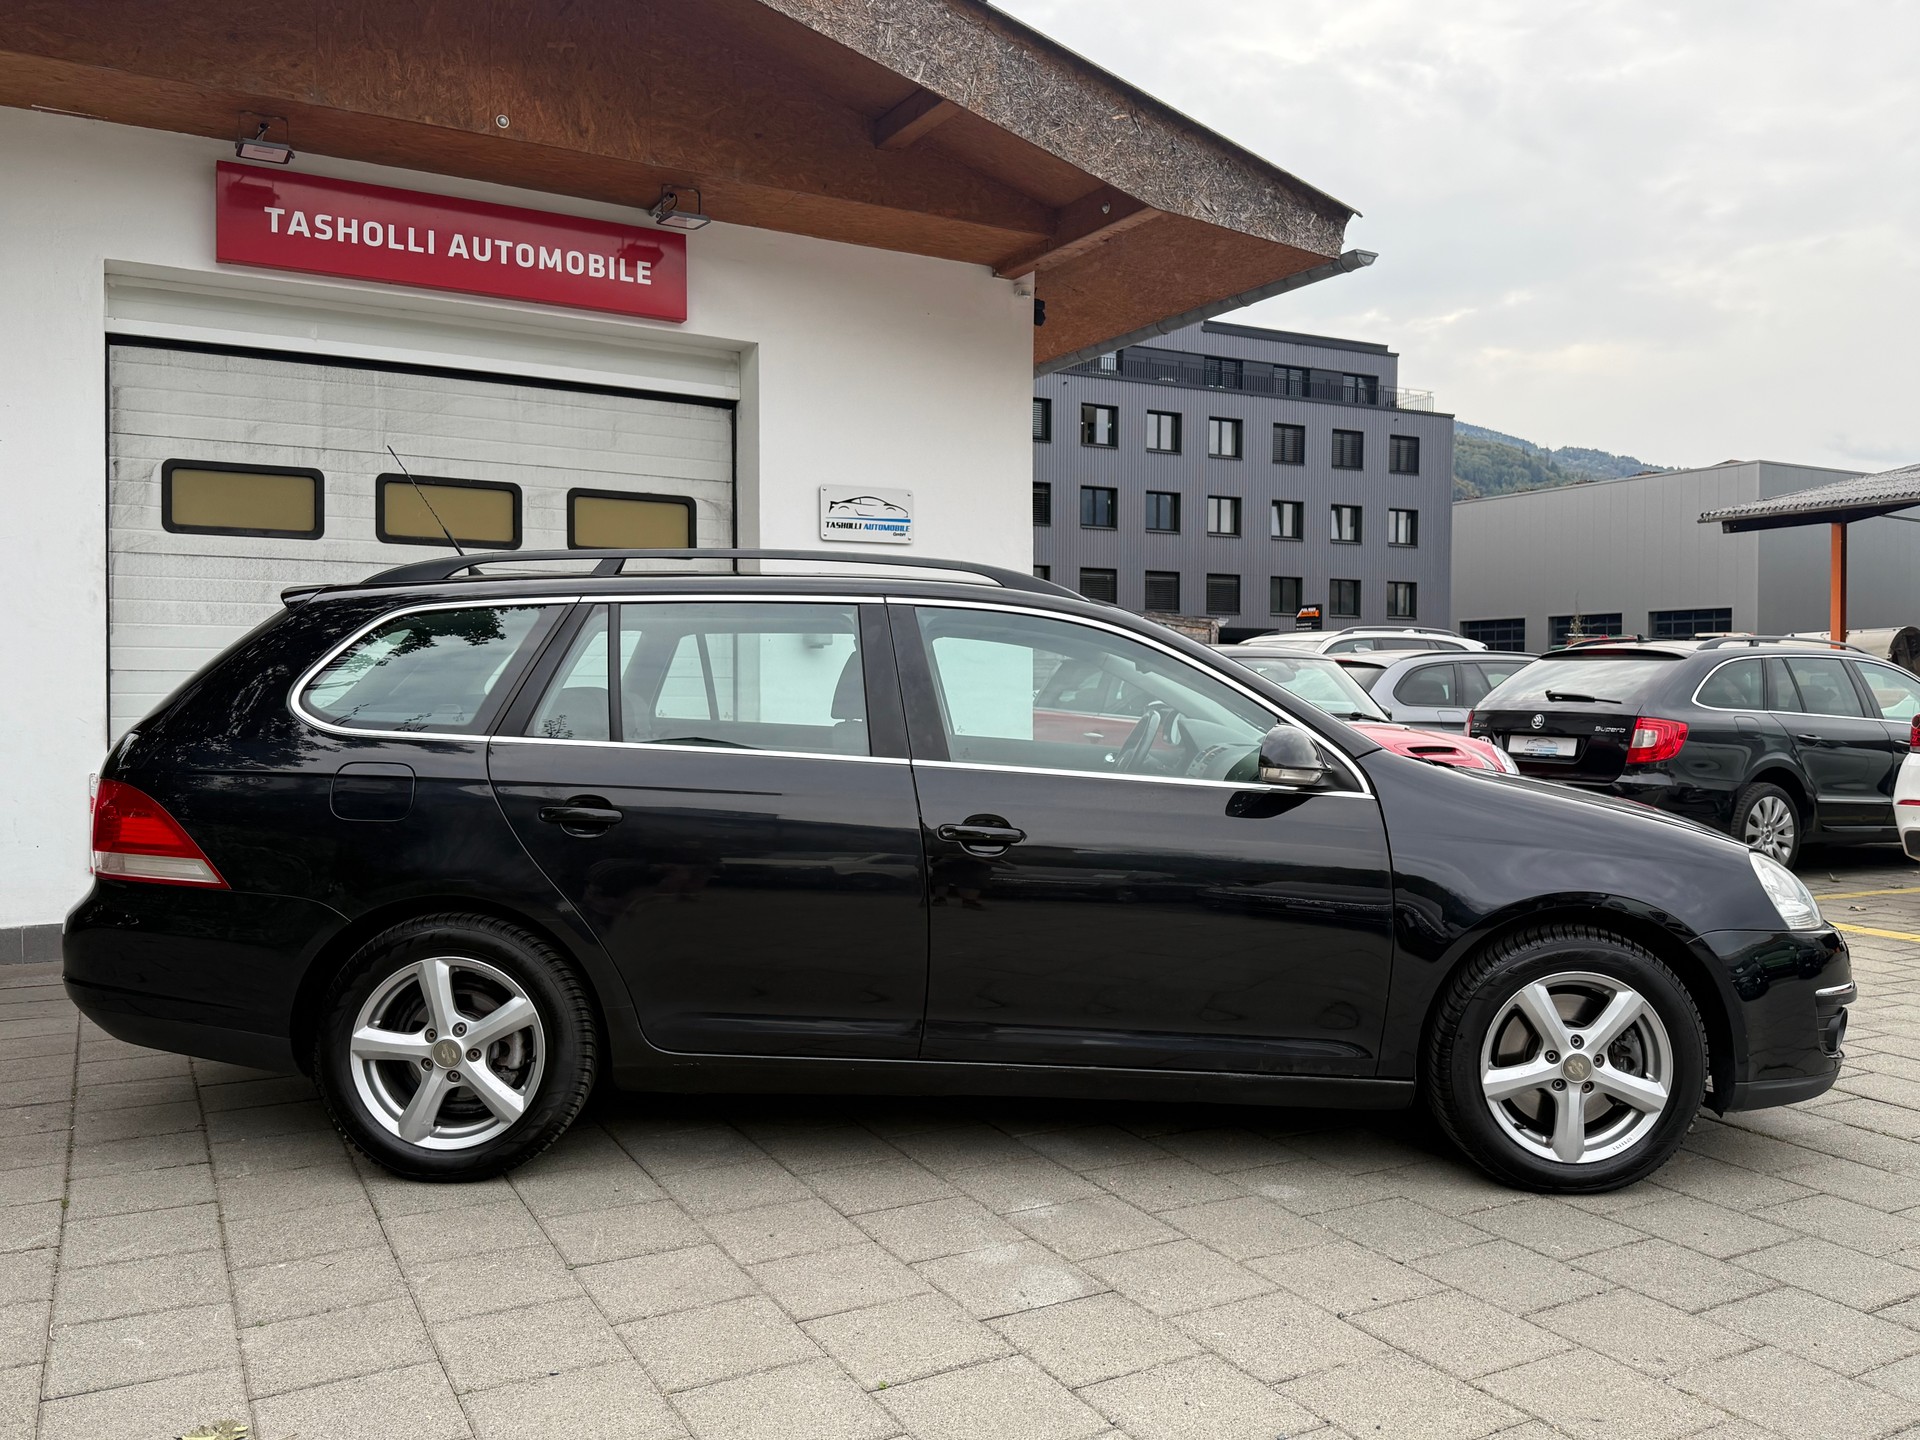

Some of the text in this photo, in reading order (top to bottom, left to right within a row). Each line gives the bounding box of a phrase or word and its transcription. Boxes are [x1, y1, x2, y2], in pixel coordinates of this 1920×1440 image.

[264, 206, 652, 285] TASHOLLI AUTOMOBILE
[825, 521, 911, 532] TASHOLLI AUTOMOBILE
[1594, 725, 1626, 733] Superb
